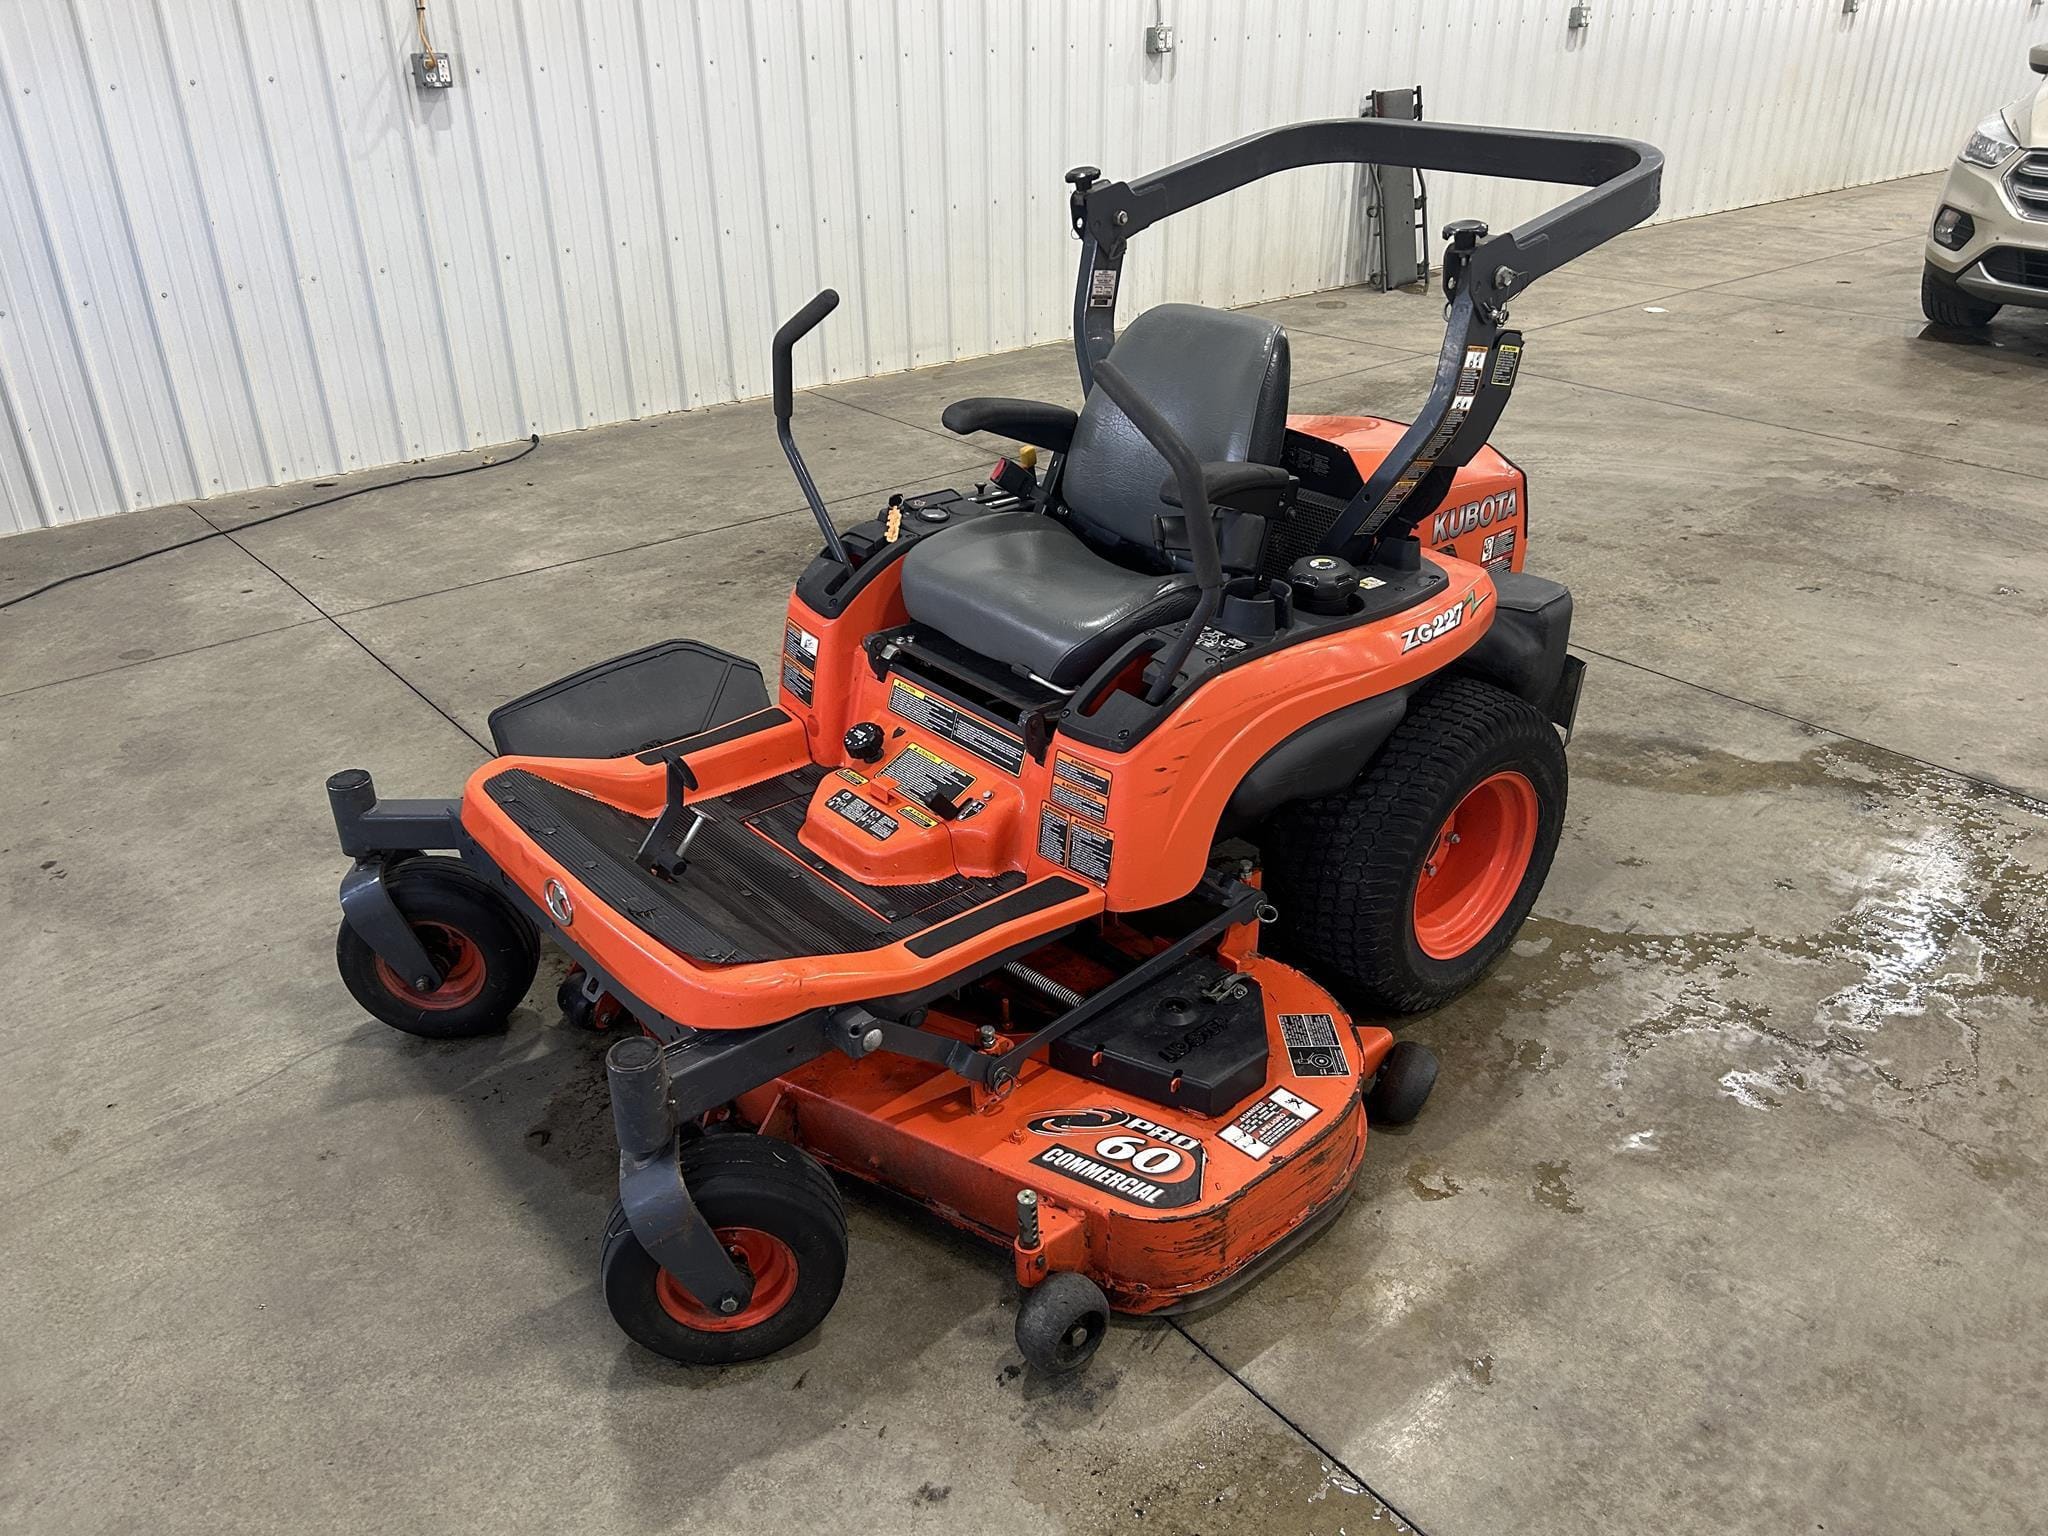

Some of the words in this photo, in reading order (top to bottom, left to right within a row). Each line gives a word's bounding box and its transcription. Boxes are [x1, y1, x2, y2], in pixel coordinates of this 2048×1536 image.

[1431, 488, 1518, 545] KUBOTA
[1064, 782, 1099, 801] ADVERTENCIA
[1077, 819, 1112, 838] ADVERTENCIA
[1242, 1101, 1266, 1119] DANGER
[1126, 1118, 1203, 1151] PRO
[1095, 1135, 1182, 1175] 60
[1041, 1148, 1166, 1204] COMMERCIAL
